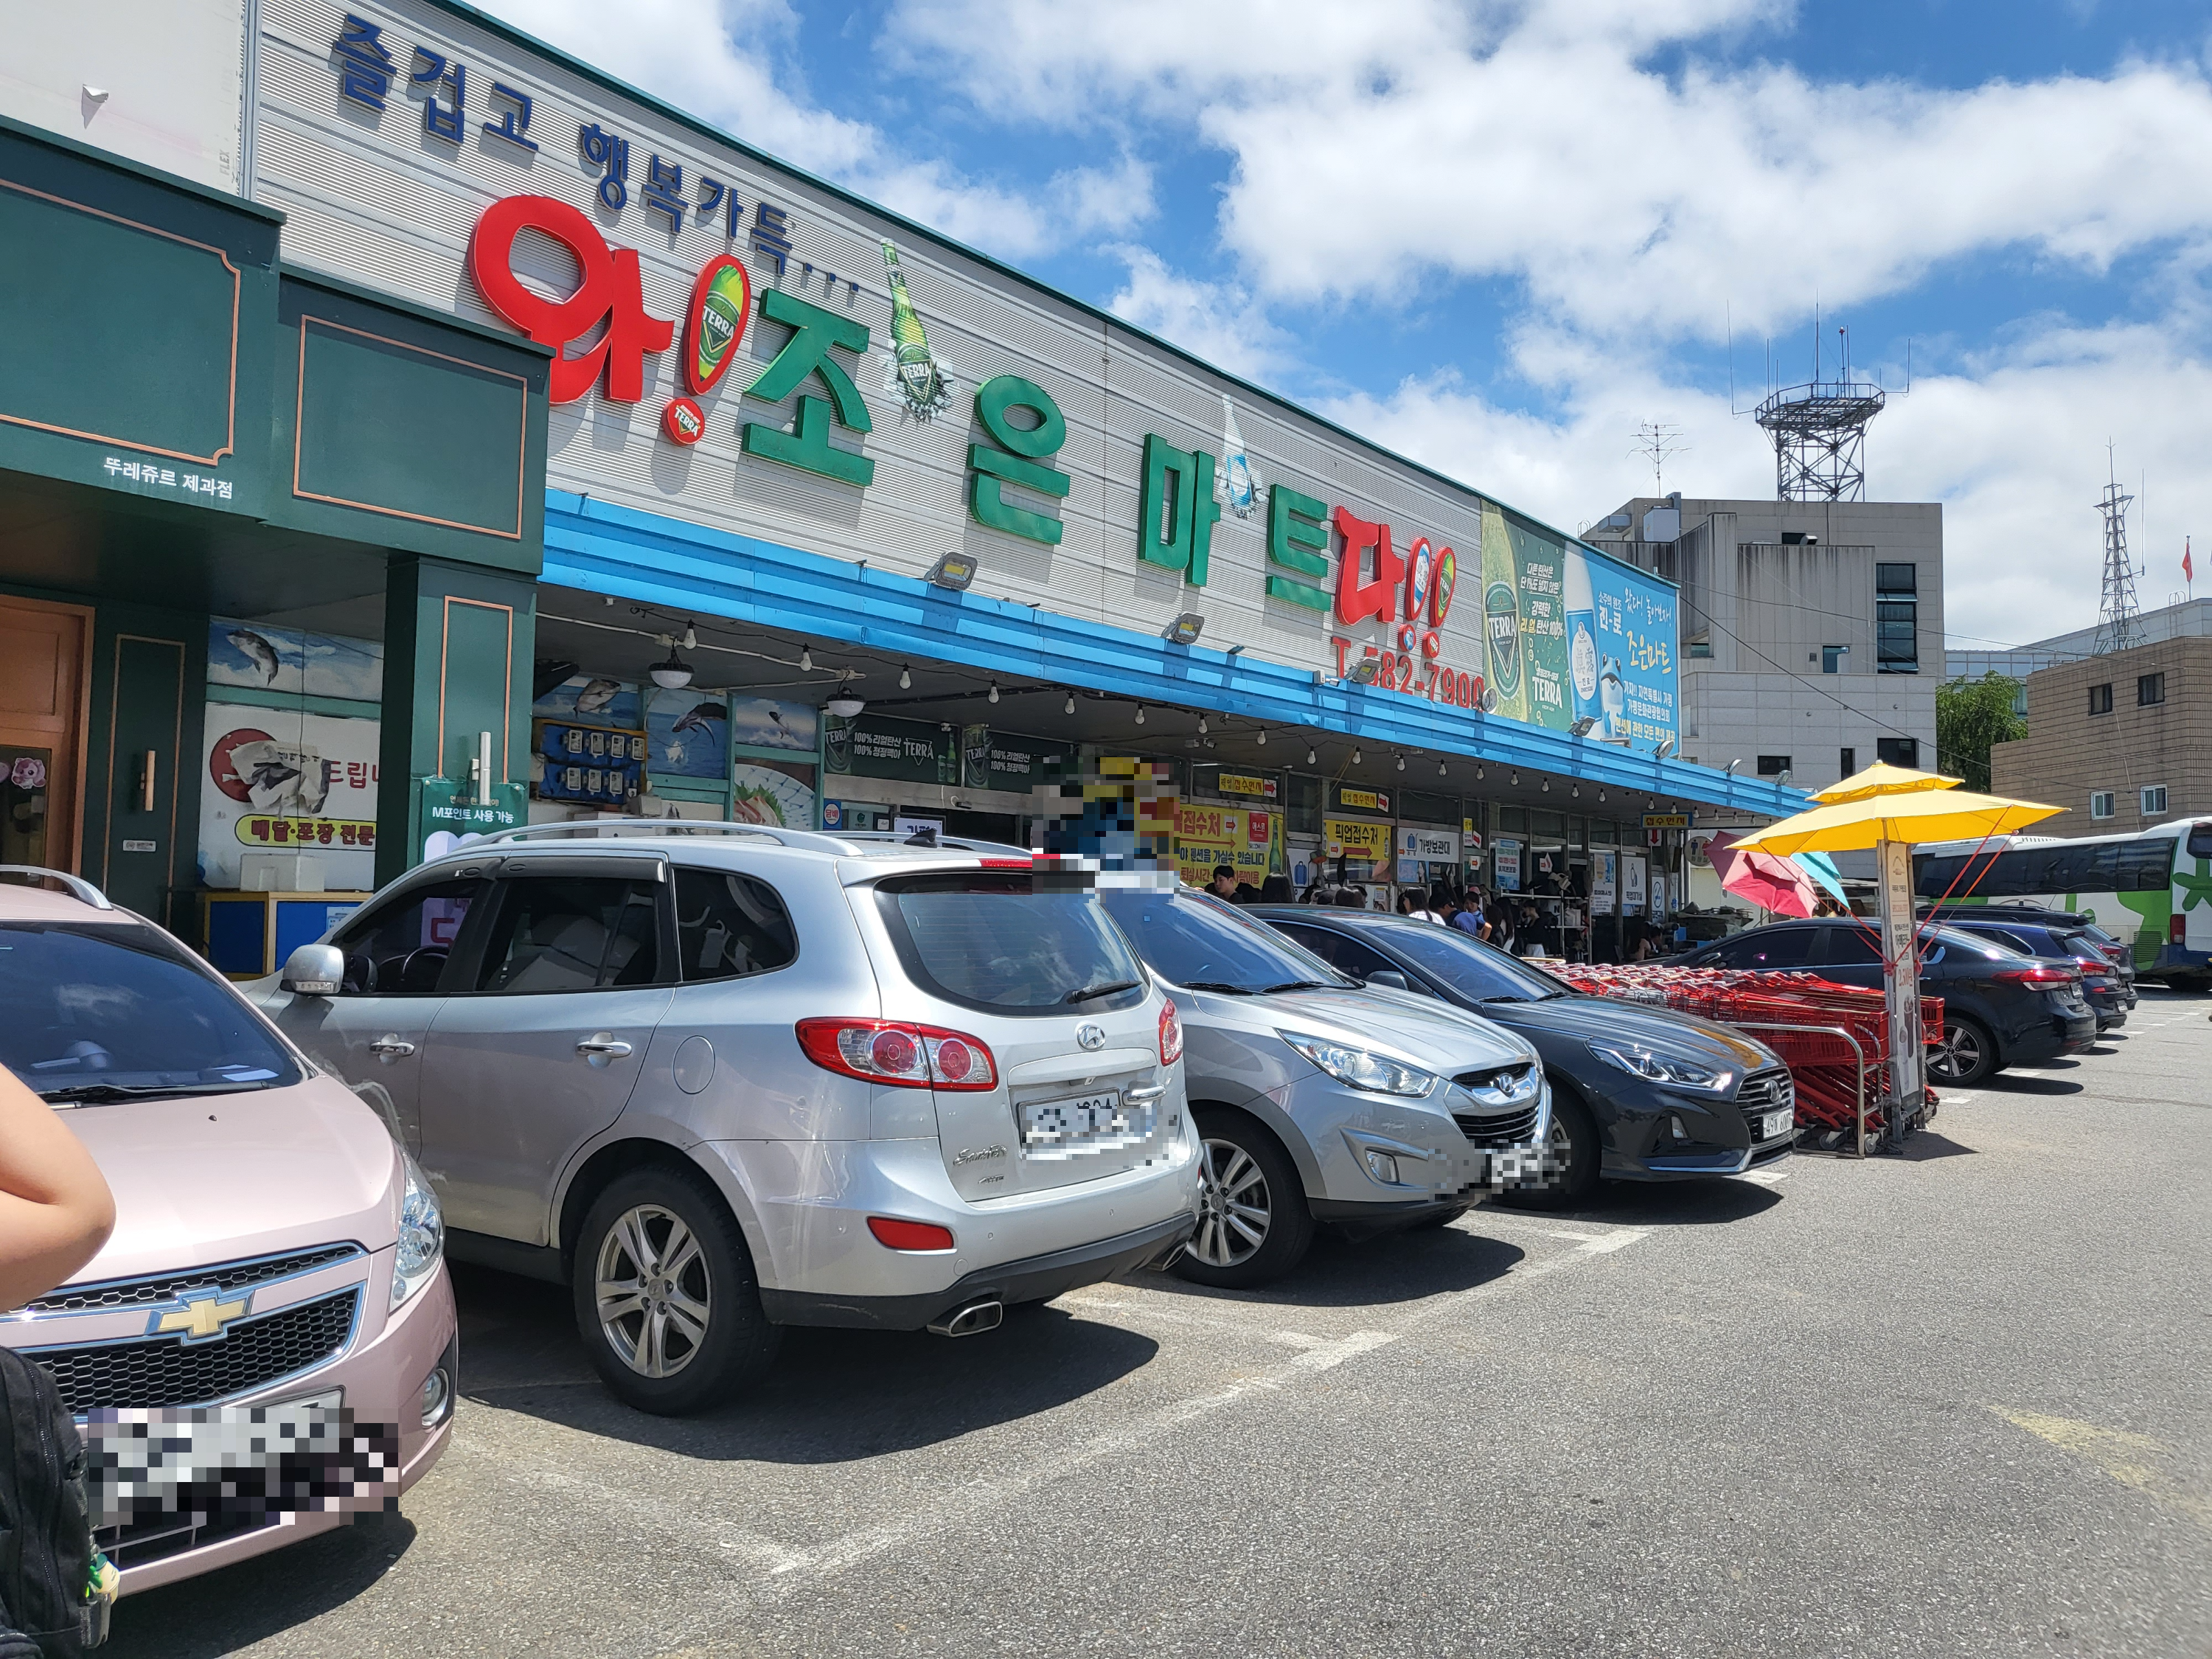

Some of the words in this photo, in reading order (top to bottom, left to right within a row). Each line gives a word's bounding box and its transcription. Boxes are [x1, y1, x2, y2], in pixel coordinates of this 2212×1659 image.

[334, 13, 539, 151] 즐겁고
[703, 305, 734, 340] TERRA
[900, 363, 932, 380] TERRA
[674, 406, 699, 438] TERRA
[103, 456, 178, 487] 뚜레쥬르
[182, 473, 233, 499] 제과점
[1531, 600, 1551, 618] 강력한
[1599, 591, 1612, 608] 소주의
[1613, 596, 1622, 611] 원조
[1624, 586, 1644, 617] 왔다!
[1488, 615, 1517, 641] TERRA
[1627, 630, 1672, 675] 조은마트
[1532, 676, 1563, 709] TERRA
[854, 731, 872, 744] 100%
[872, 734, 902, 748] 리얼탄산
[854, 744, 872, 756] 100%
[903, 740, 934, 760] TERRA
[991, 749, 1006, 760] 100%
[990, 760, 1006, 771] 100%
[432, 806, 472, 821] M포인트
[473, 810, 495, 823] 사용
[495, 810, 515, 824] 가능
[1180, 810, 1220, 838] 접수처
[340, 824, 375, 846] 전문
[1335, 824, 1378, 846] 픽업접수처
[1419, 838, 1451, 855] 가방보관대
[1237, 851, 1265, 866] 있습니다
